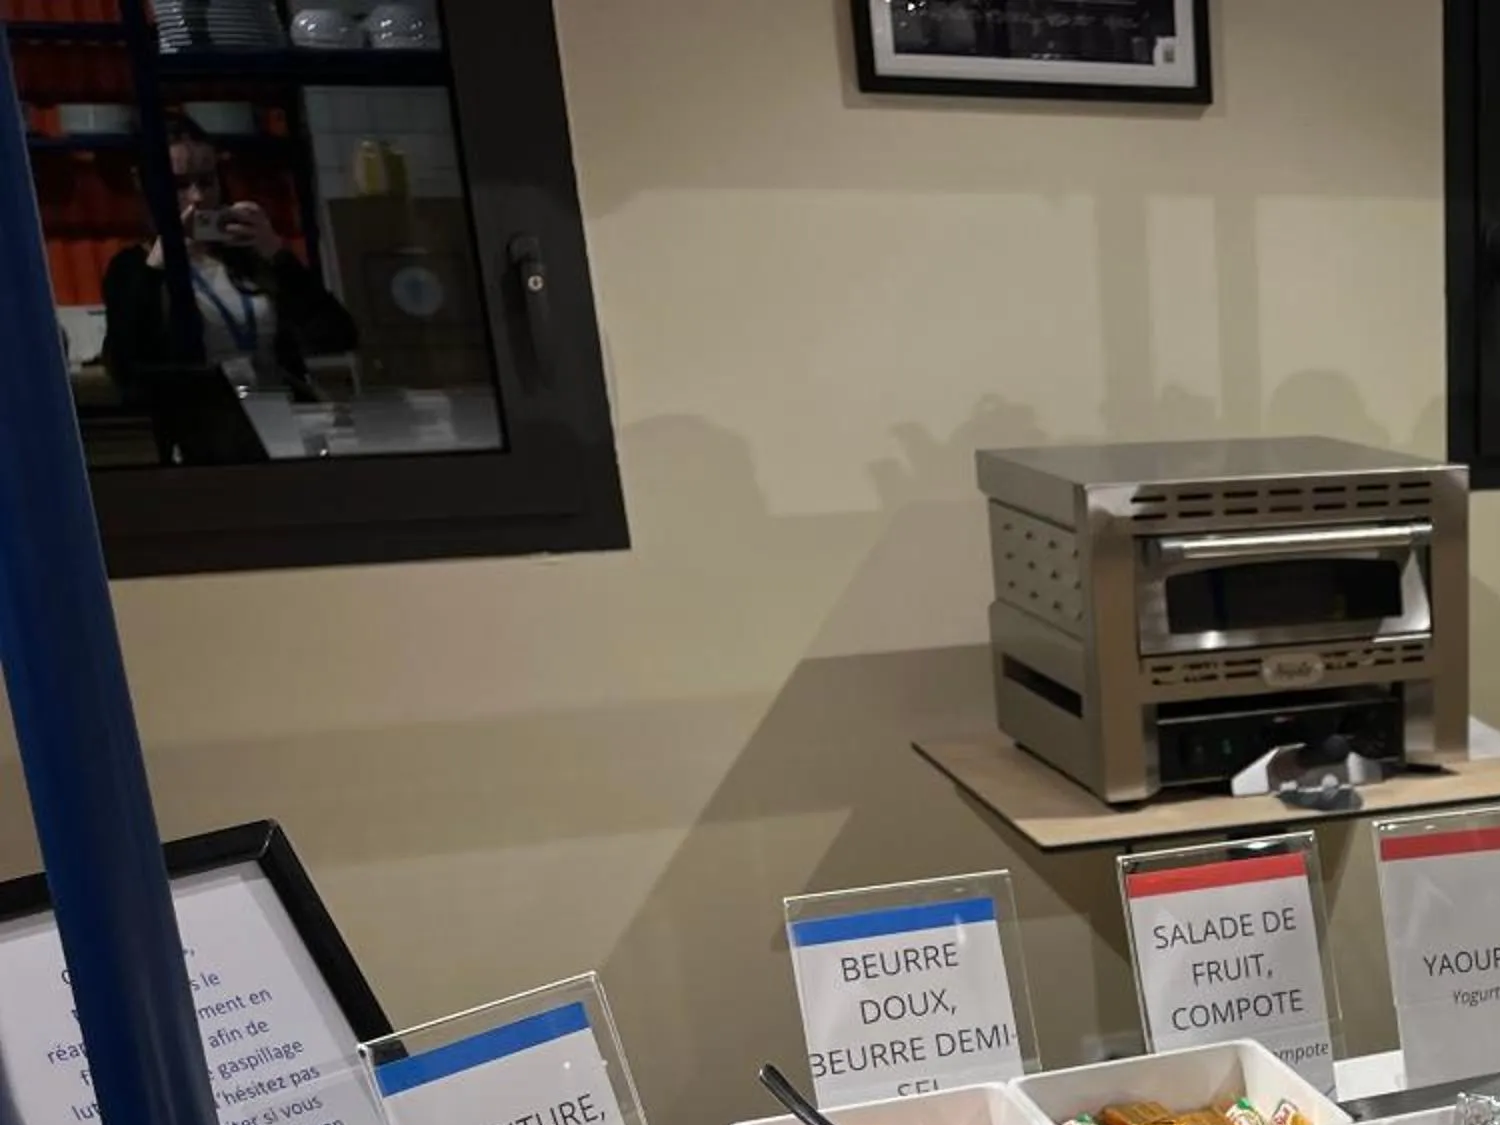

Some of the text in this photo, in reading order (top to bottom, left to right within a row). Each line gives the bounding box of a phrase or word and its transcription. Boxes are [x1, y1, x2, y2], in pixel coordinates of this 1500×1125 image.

[1153, 908, 1296, 949] SALADE DE
[201, 972, 221, 987] le
[841, 942, 959, 982] BEURRE
[1192, 953, 1273, 986] FRUIT,
[249, 988, 273, 1005] en
[860, 989, 956, 1024] DOUX,
[1172, 990, 1303, 1031] COMPOTE
[1453, 986, 1500, 1007] Yogurt
[208, 1020, 270, 1048] afin de
[217, 1041, 304, 1080] gaspillage
[810, 1037, 926, 1077] BEURRE
[215, 1066, 320, 1108] 'hésitez pas
[264, 1111, 278, 1124] si
[280, 1096, 323, 1119] vous
